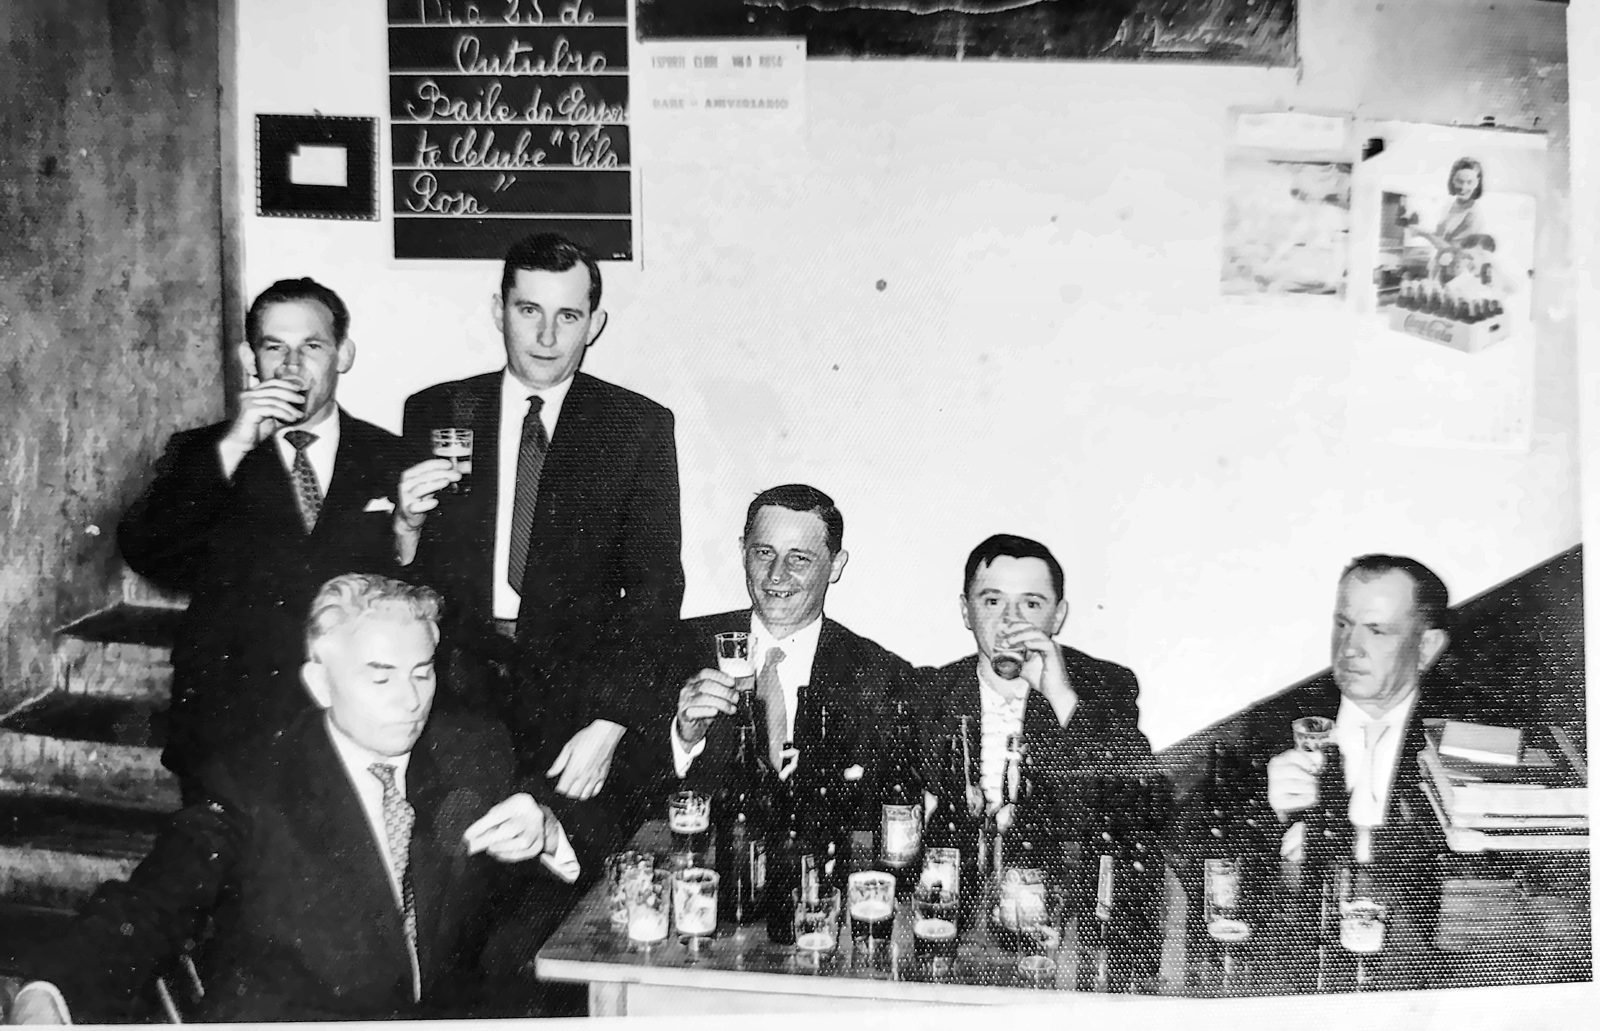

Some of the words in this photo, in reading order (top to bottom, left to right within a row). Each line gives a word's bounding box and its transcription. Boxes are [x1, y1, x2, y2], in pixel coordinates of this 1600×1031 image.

[560, 0, 595, 25] de
[456, 35, 607, 76] Outubro
[407, 81, 517, 121] Baile
[452, 127, 547, 168] Clube
